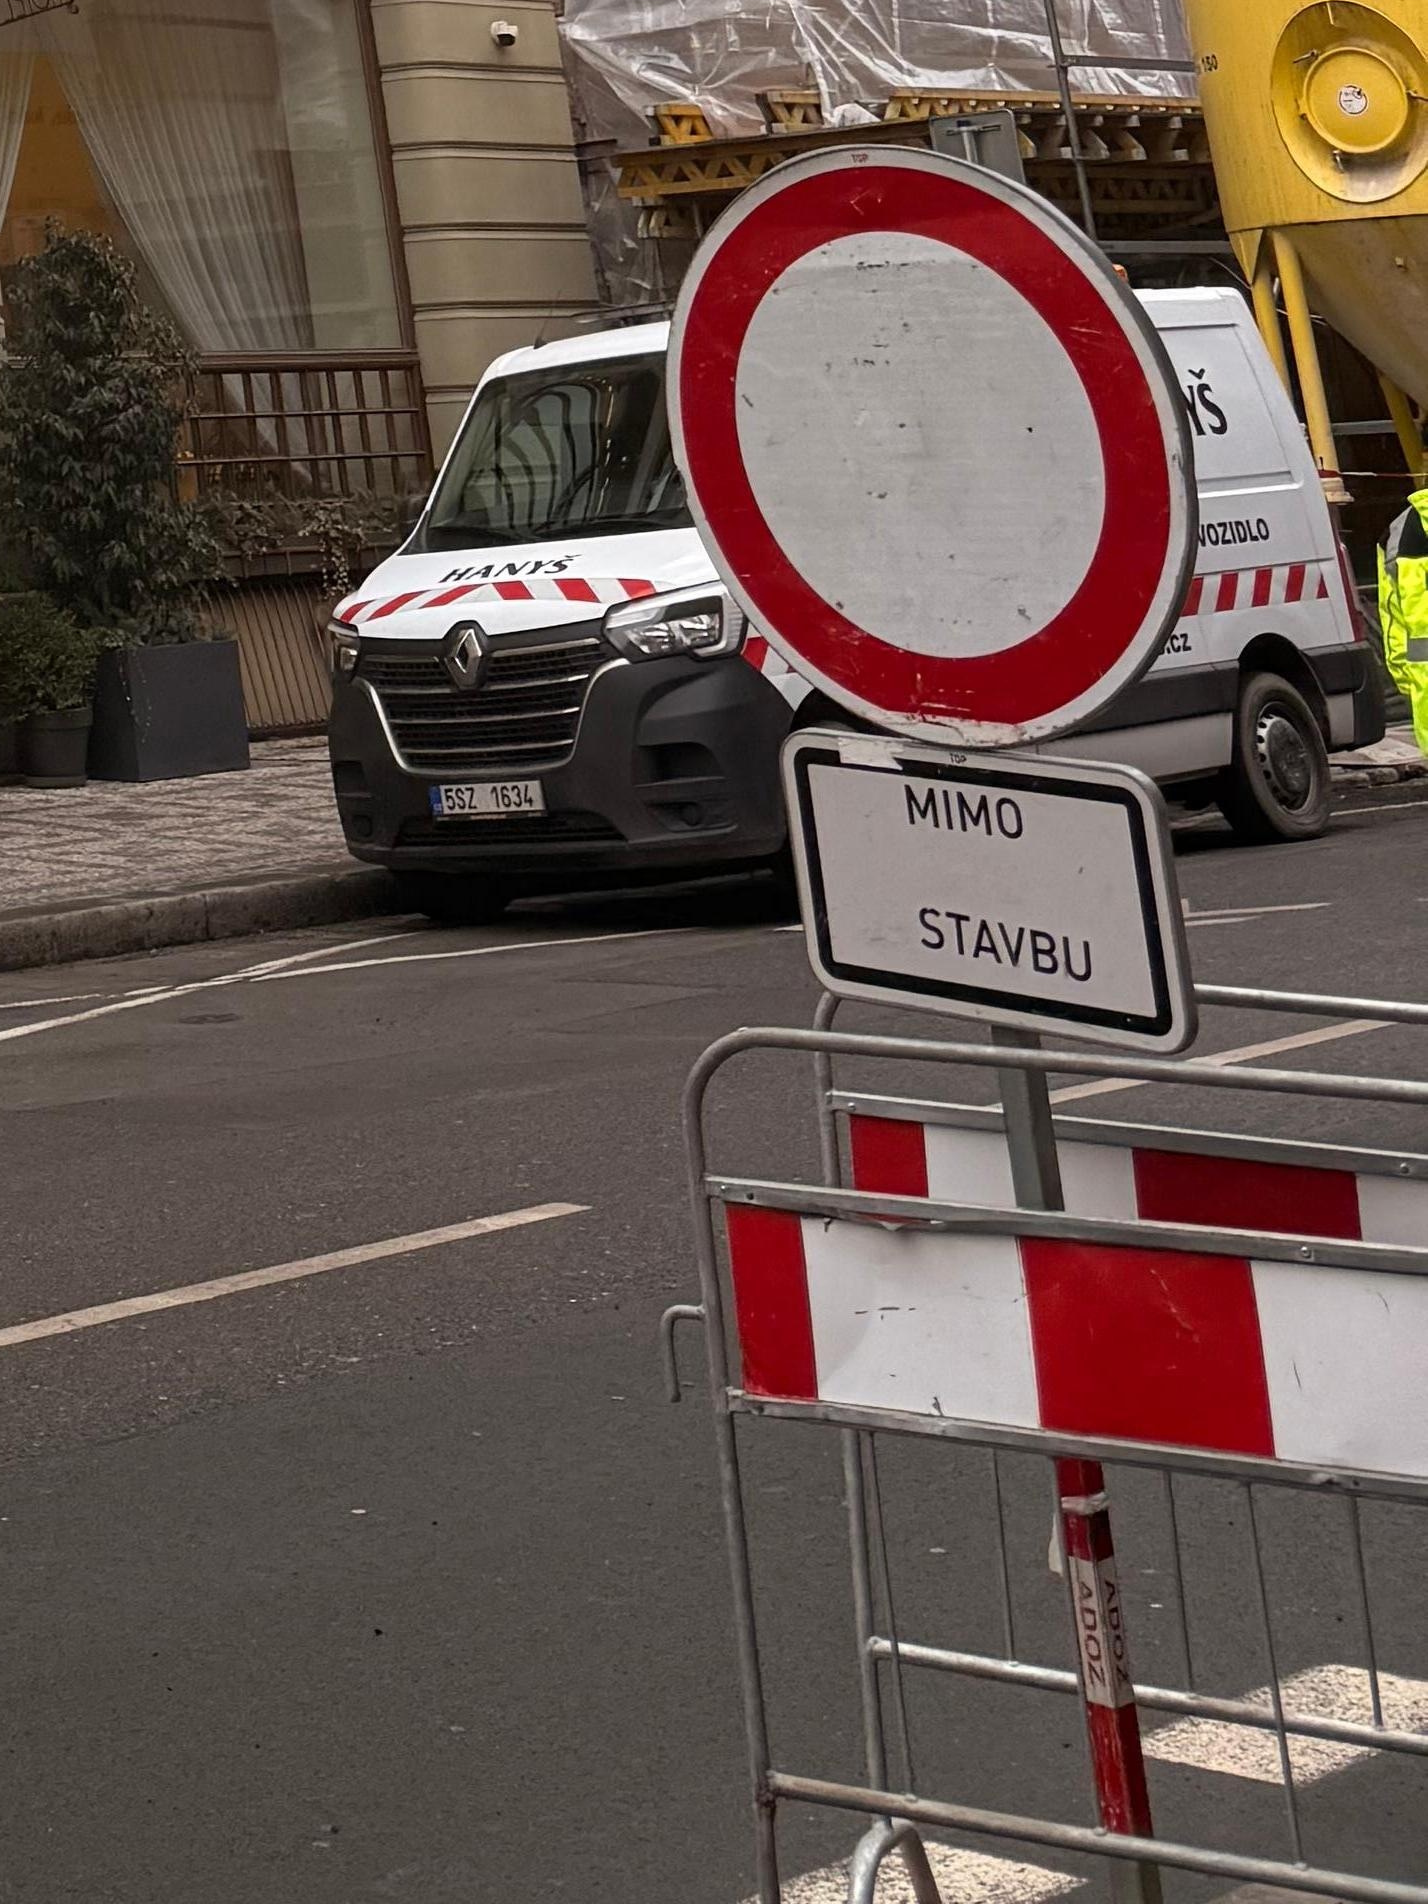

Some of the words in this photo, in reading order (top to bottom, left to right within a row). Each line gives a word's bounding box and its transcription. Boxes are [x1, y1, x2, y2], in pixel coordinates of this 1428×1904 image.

[438, 554, 582, 583] HANYŠ
[444, 787, 477, 811] 5SZ
[490, 784, 533, 809] 1634
[904, 784, 1024, 840] MIMO
[919, 907, 1093, 982] STAVBU
[1079, 1580, 1106, 1688] ADOZ
